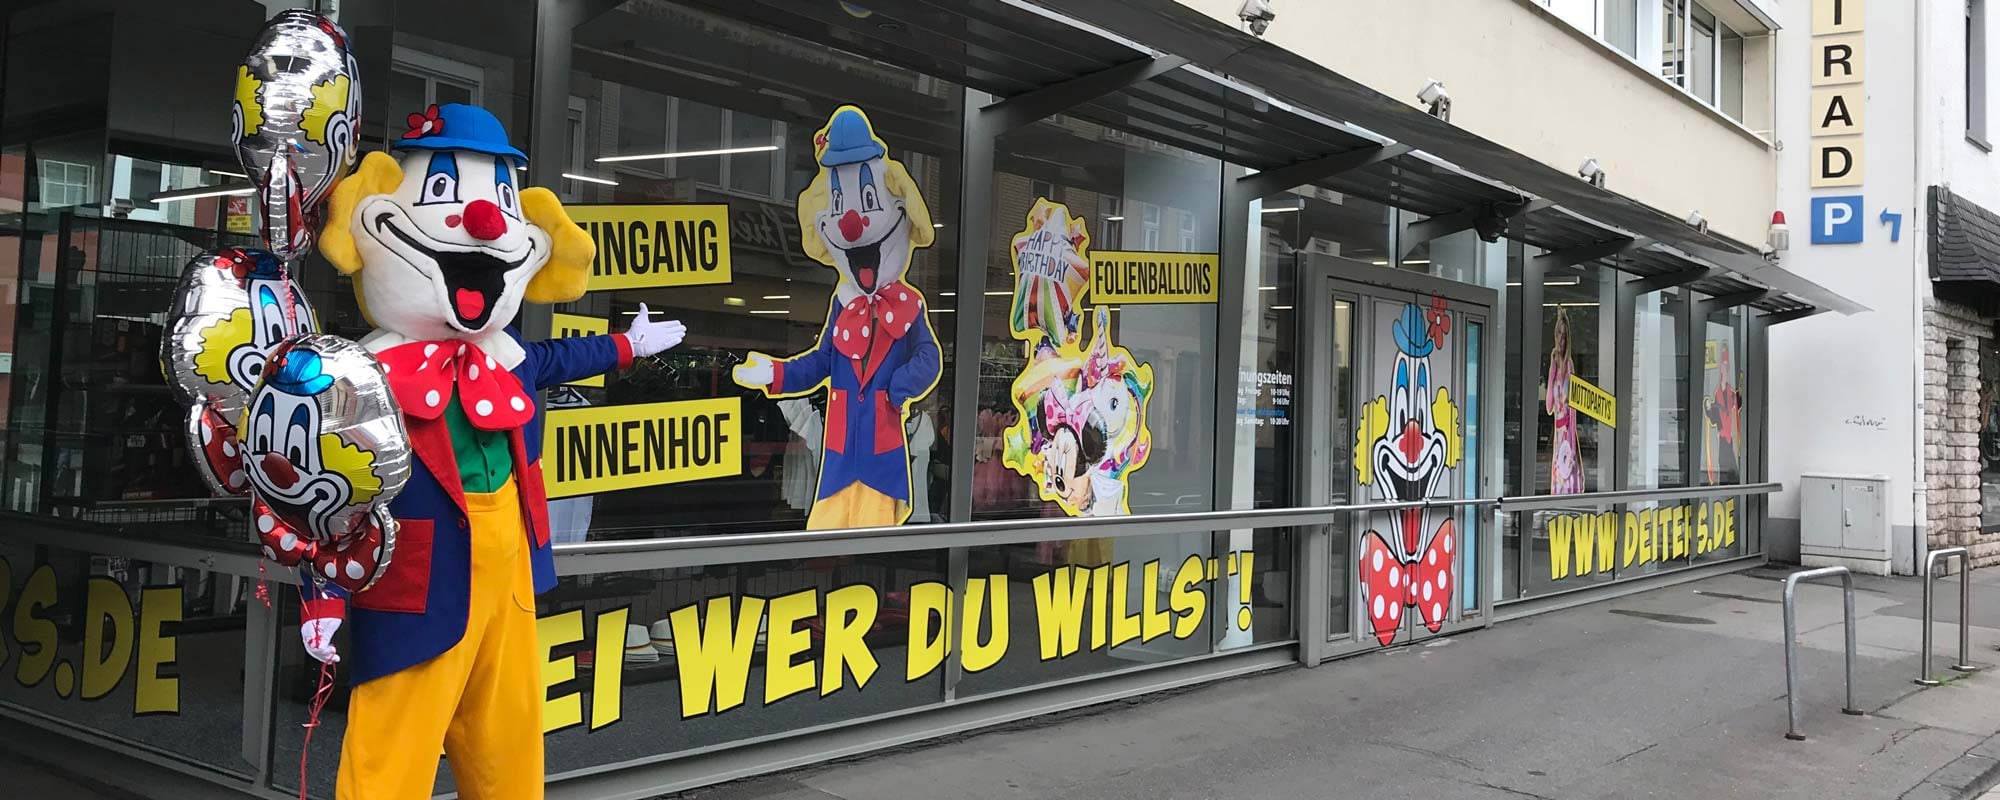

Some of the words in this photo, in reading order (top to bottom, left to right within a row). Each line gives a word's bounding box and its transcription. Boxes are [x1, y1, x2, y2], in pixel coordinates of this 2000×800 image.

[1824, 203, 1853, 236] P
[575, 220, 719, 276] INGANG
[1018, 251, 1069, 284] BIRTHDAY
[1095, 260, 1211, 296] FOLIENBALLONS
[1239, 368, 1292, 388] nungszeiten
[1571, 380, 1612, 420] MOTTOPARTYS
[556, 413, 730, 483] INNENHOF
[0, 554, 185, 719] S.DE
[535, 608, 631, 734] EI
[668, 583, 881, 721] WER
[905, 573, 1010, 684] DU
